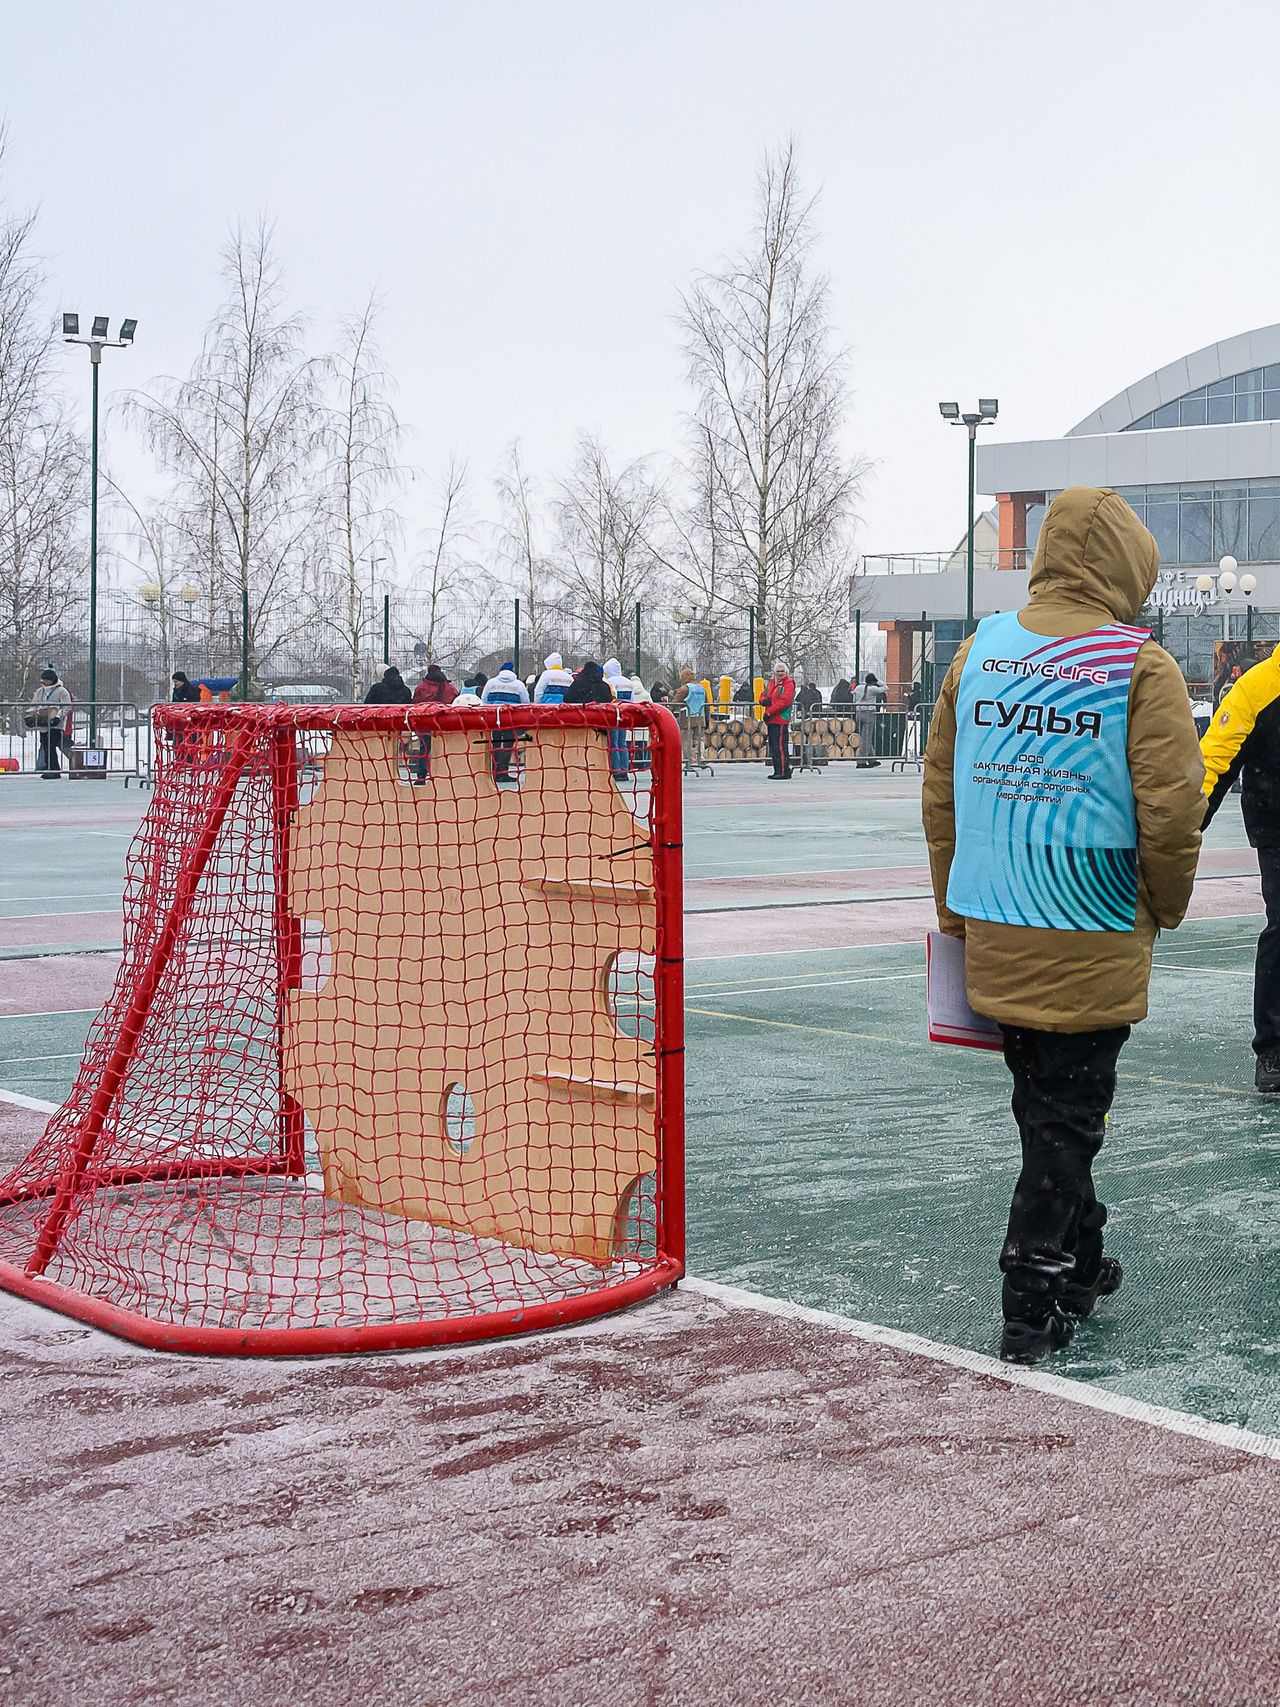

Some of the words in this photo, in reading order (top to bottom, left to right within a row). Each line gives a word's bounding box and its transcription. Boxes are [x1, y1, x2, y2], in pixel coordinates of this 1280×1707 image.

[974, 700, 1101, 739] СУДЬЯ
[1018, 754, 1044, 763] ООО
[1043, 768, 1092, 782] ЖИЗНЬ»
[973, 775, 1030, 788] организация
[1031, 781, 1091, 794] спортивных
[996, 791, 1062, 804] мероприятий
